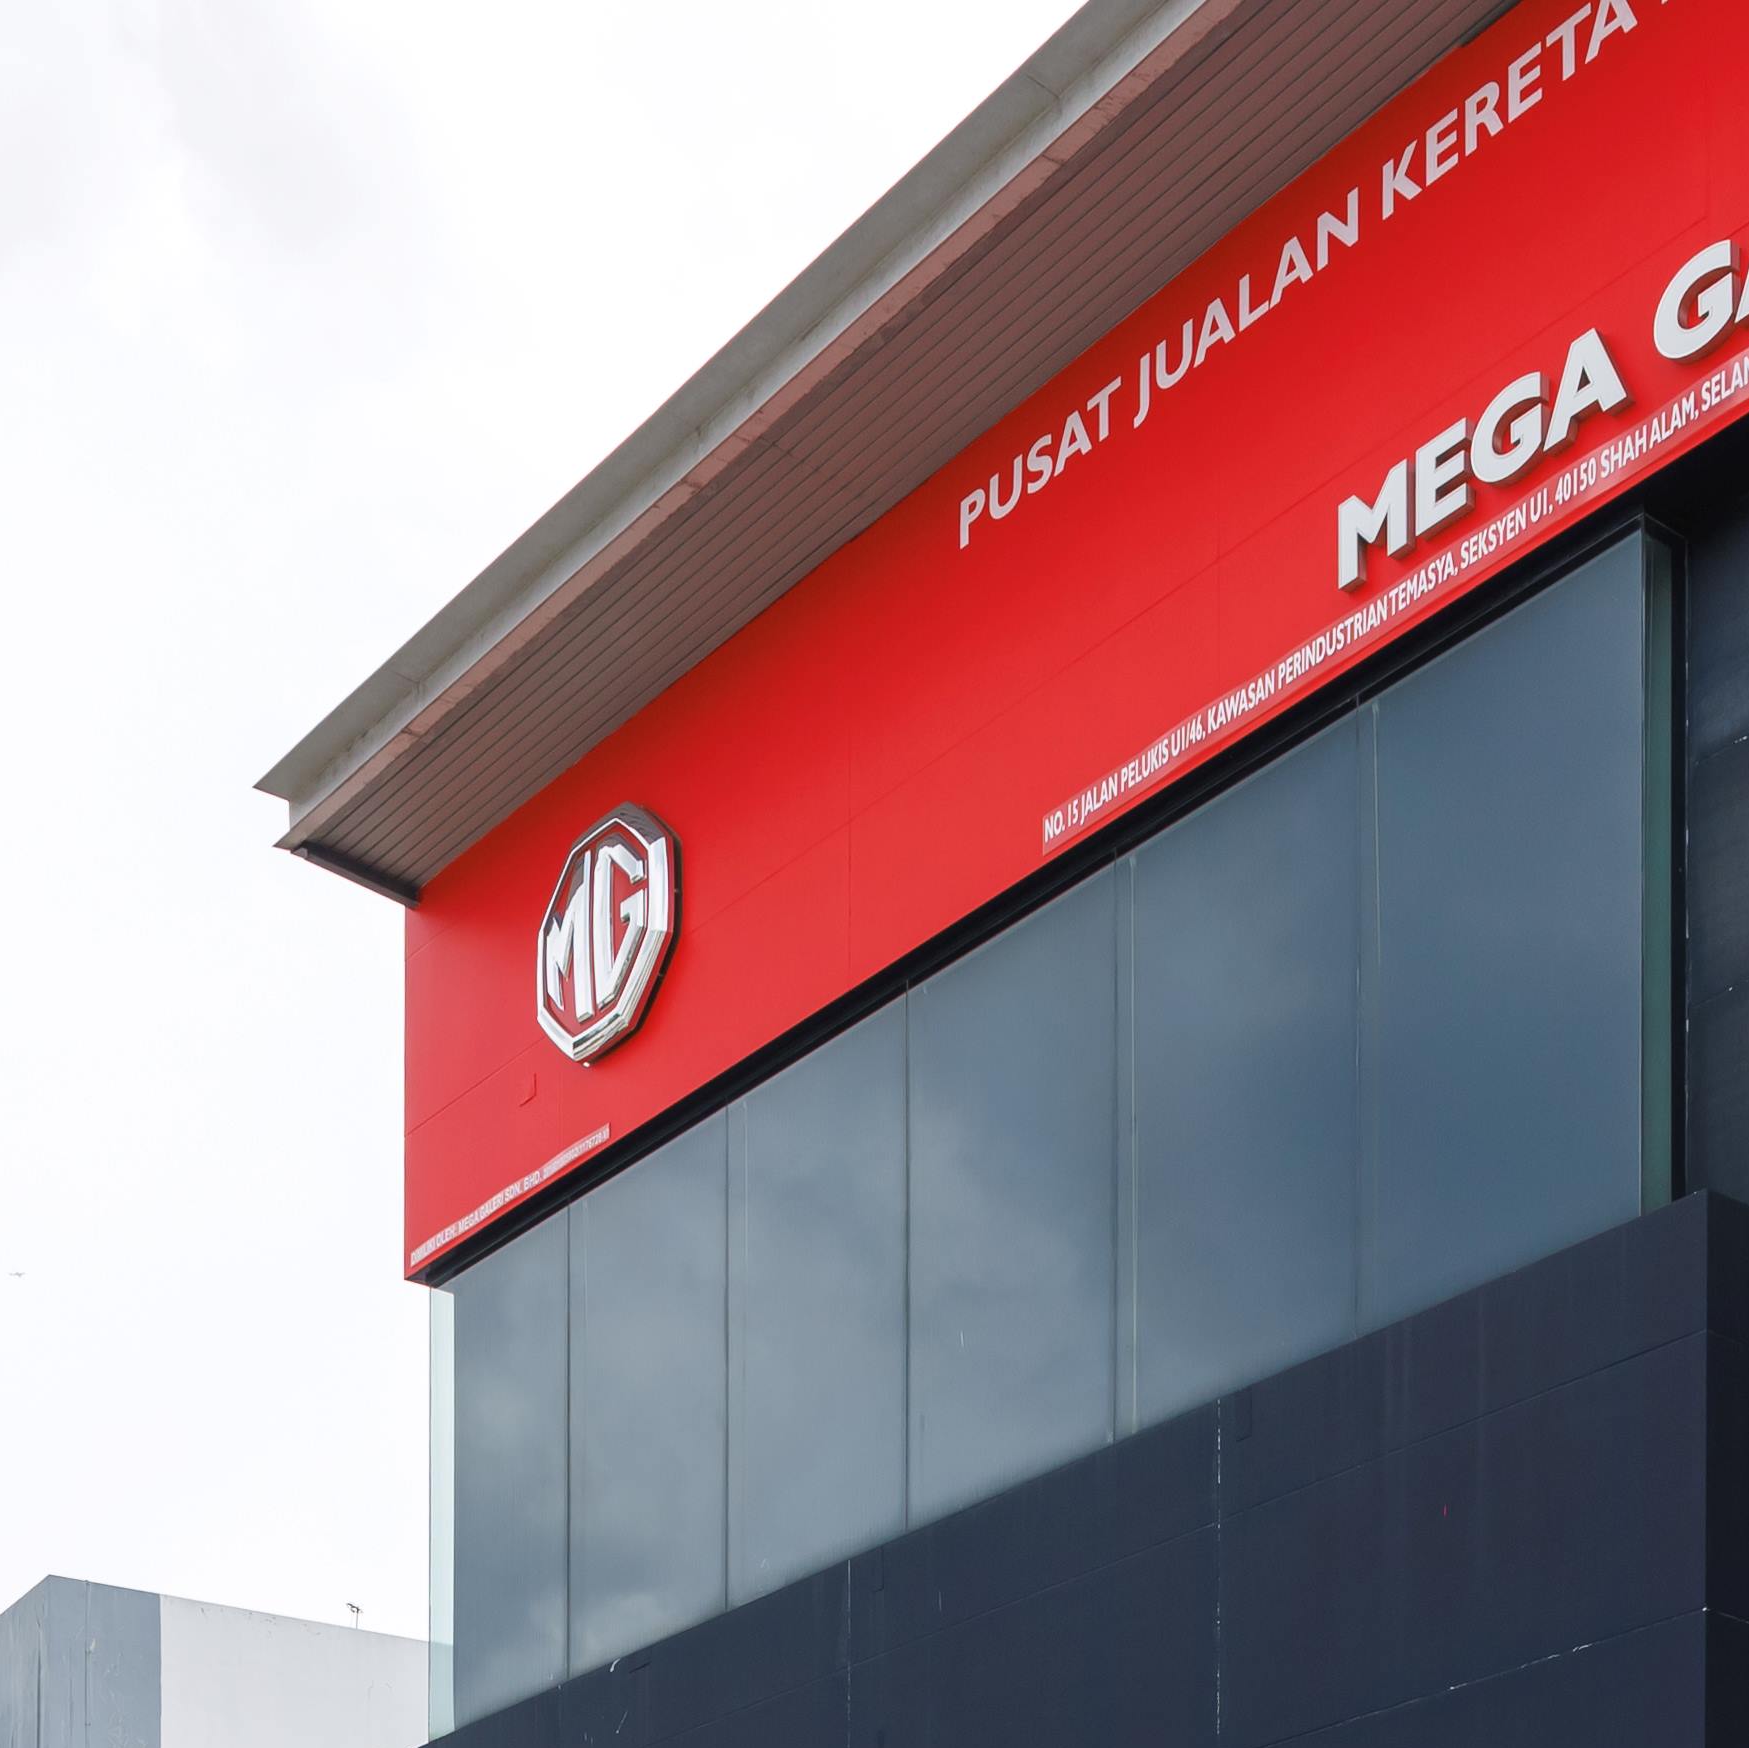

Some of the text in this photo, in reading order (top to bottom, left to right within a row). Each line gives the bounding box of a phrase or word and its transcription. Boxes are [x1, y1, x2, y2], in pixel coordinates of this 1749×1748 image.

[958, 0, 1639, 550] PUSAT JUALAN KERETA
[1043, 813, 1065, 843] NO.
[1079, 773, 1119, 826] JALAN
[1120, 737, 1169, 793] PELUKIS
[1206, 672, 1276, 733] KAWASAN
[1277, 597, 1389, 691] PERINDUSTRIAN
[1386, 556, 1460, 617] TEMASYA,
[1460, 506, 1527, 569] SEKSYEN
[1554, 461, 1597, 508] 40150
[1599, 434, 1648, 479] SHAH
[1648, 392, 1700, 448] ALAM,
[1338, 327, 1634, 592] MEGA
[543, 840, 652, 1026] MG
